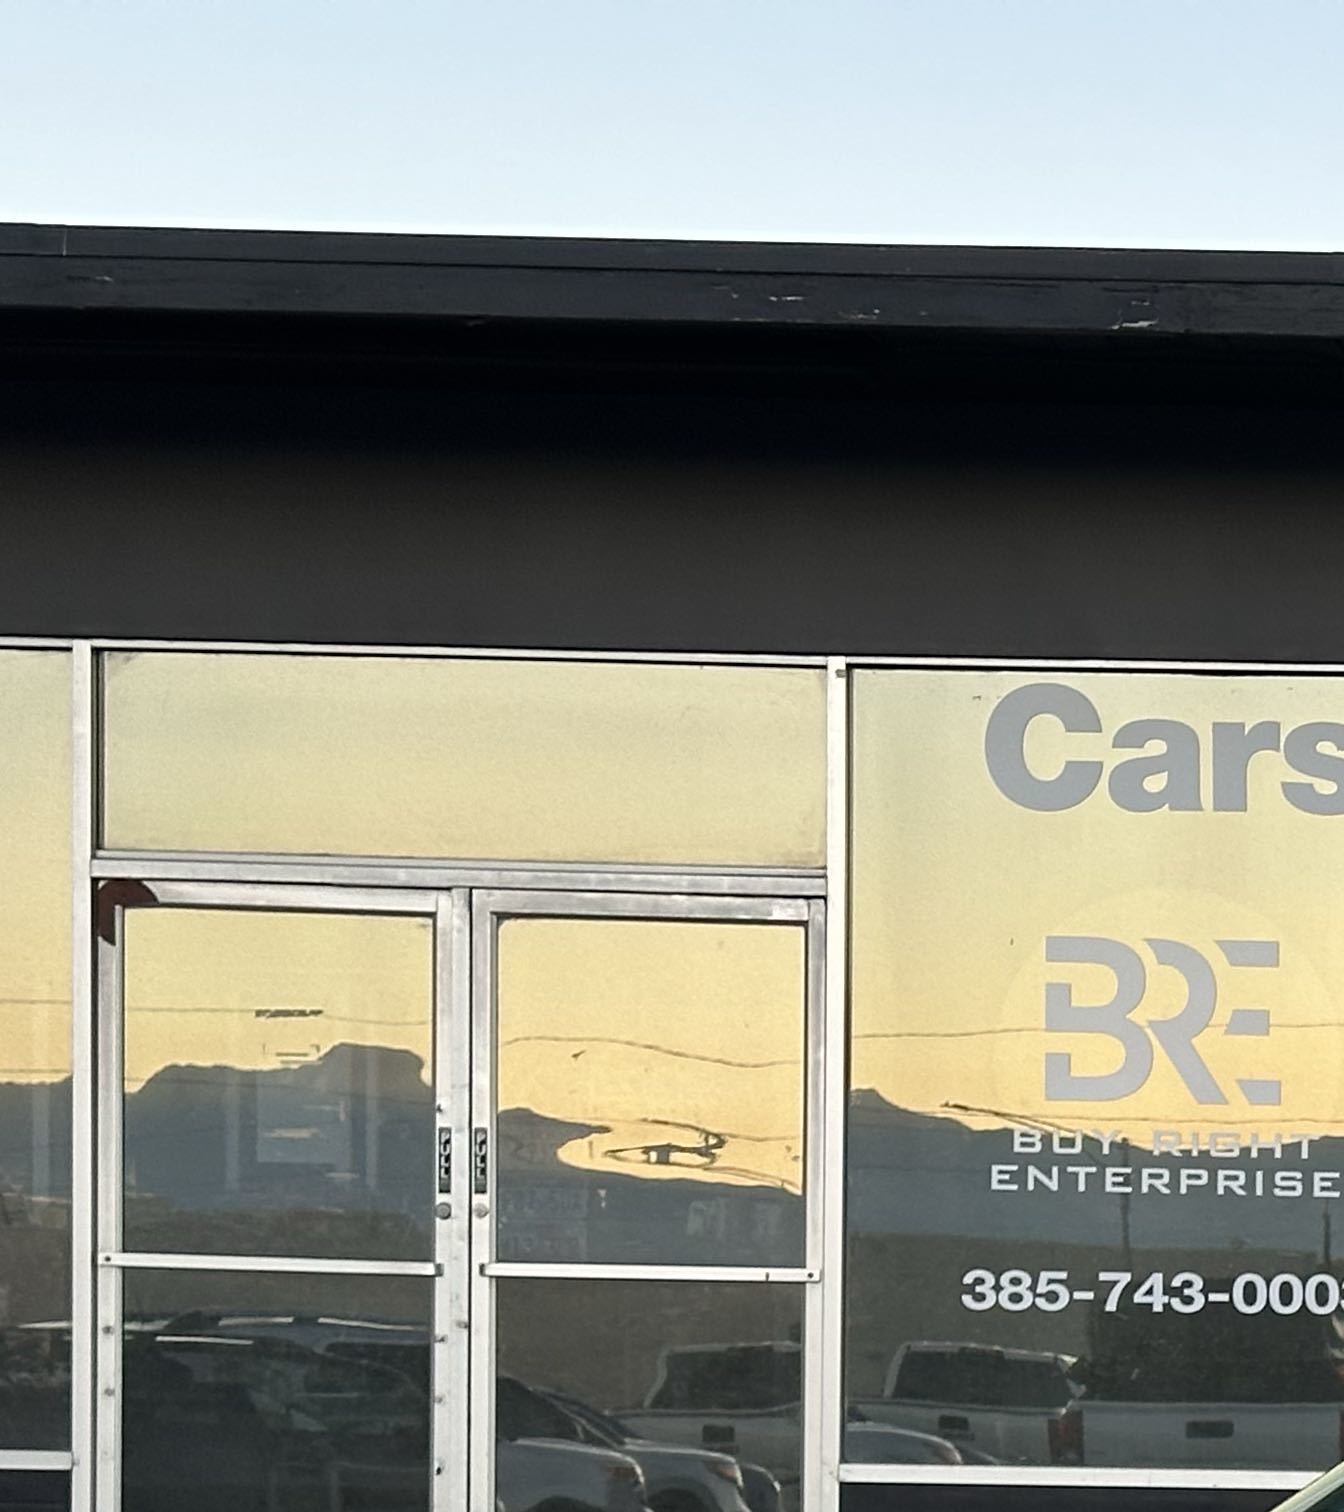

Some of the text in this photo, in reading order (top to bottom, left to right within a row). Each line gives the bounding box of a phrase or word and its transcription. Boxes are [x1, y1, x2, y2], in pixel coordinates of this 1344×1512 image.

[1044, 934, 1282, 1107] BRE
[1012, 1129, 1322, 1161] BUY RIGHT
[990, 1164, 1342, 1199] ENTERPRISE
